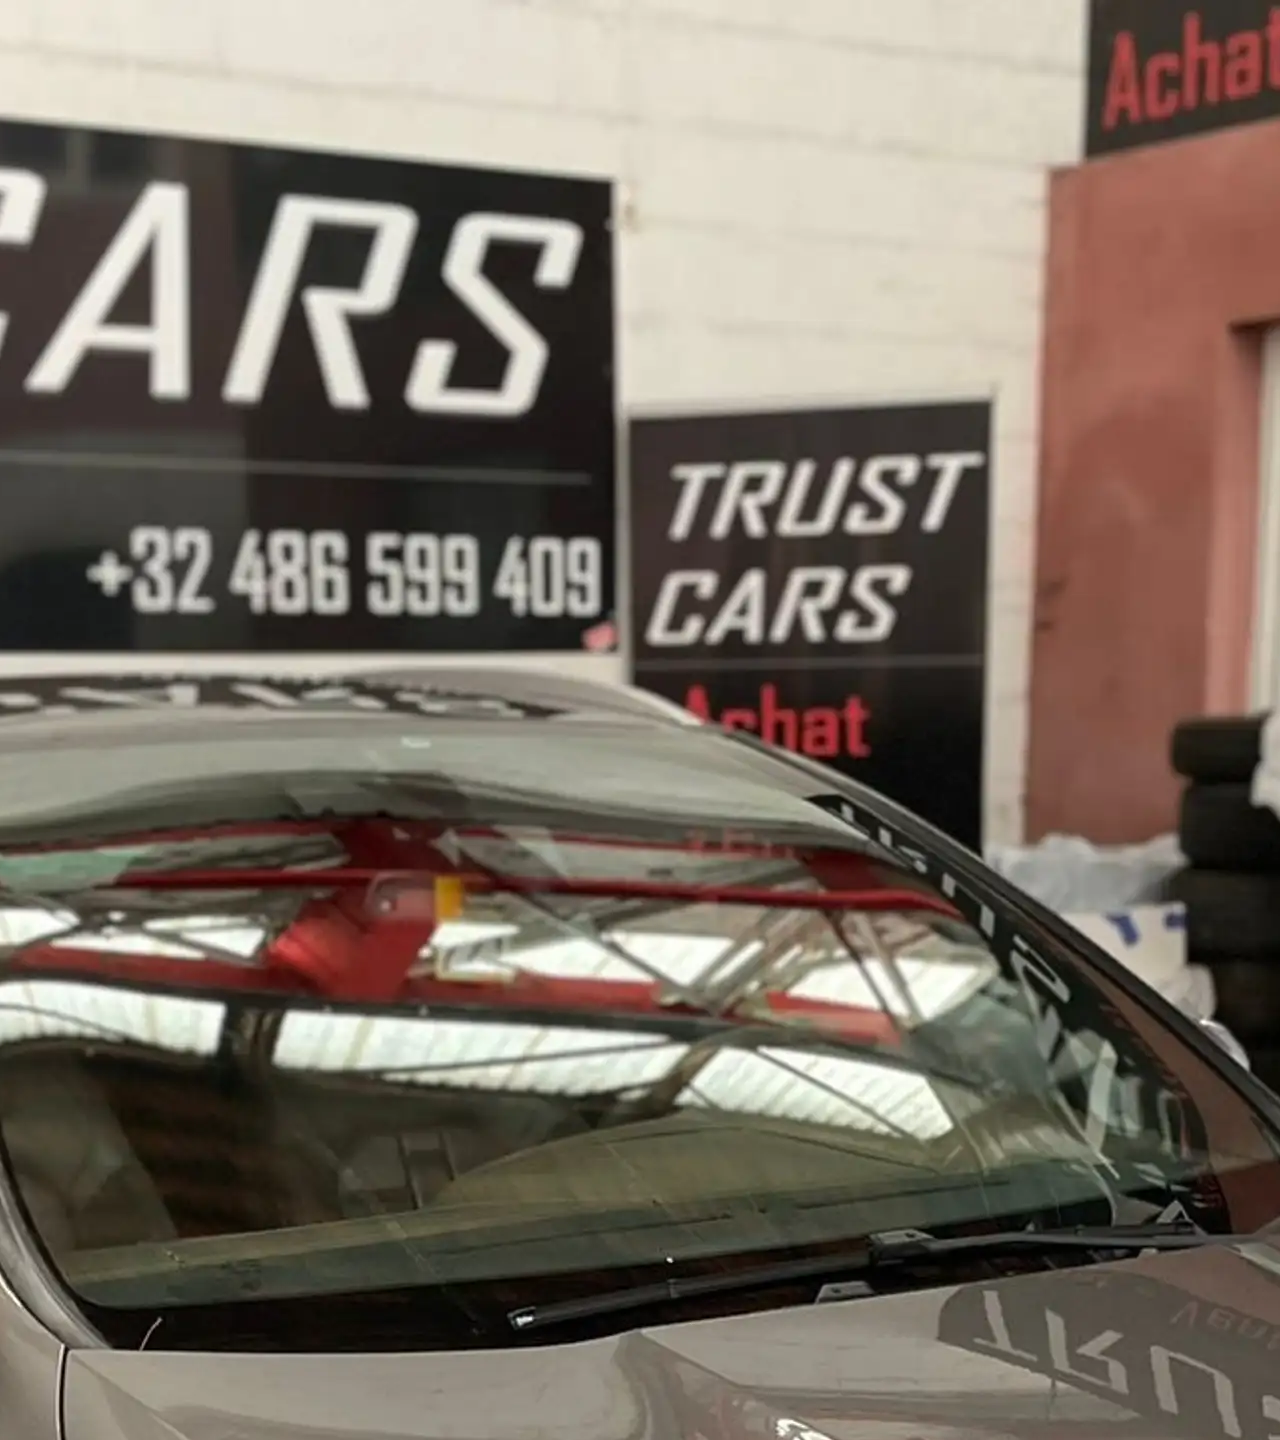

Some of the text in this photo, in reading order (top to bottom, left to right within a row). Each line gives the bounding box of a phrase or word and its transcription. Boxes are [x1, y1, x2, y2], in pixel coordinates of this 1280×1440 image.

[668, 451, 986, 541] TRUST
[86, 526, 215, 614] +32
[228, 529, 350, 615] 486
[366, 532, 480, 617] 599
[493, 536, 603, 617] 409
[645, 563, 913, 647] CARS
